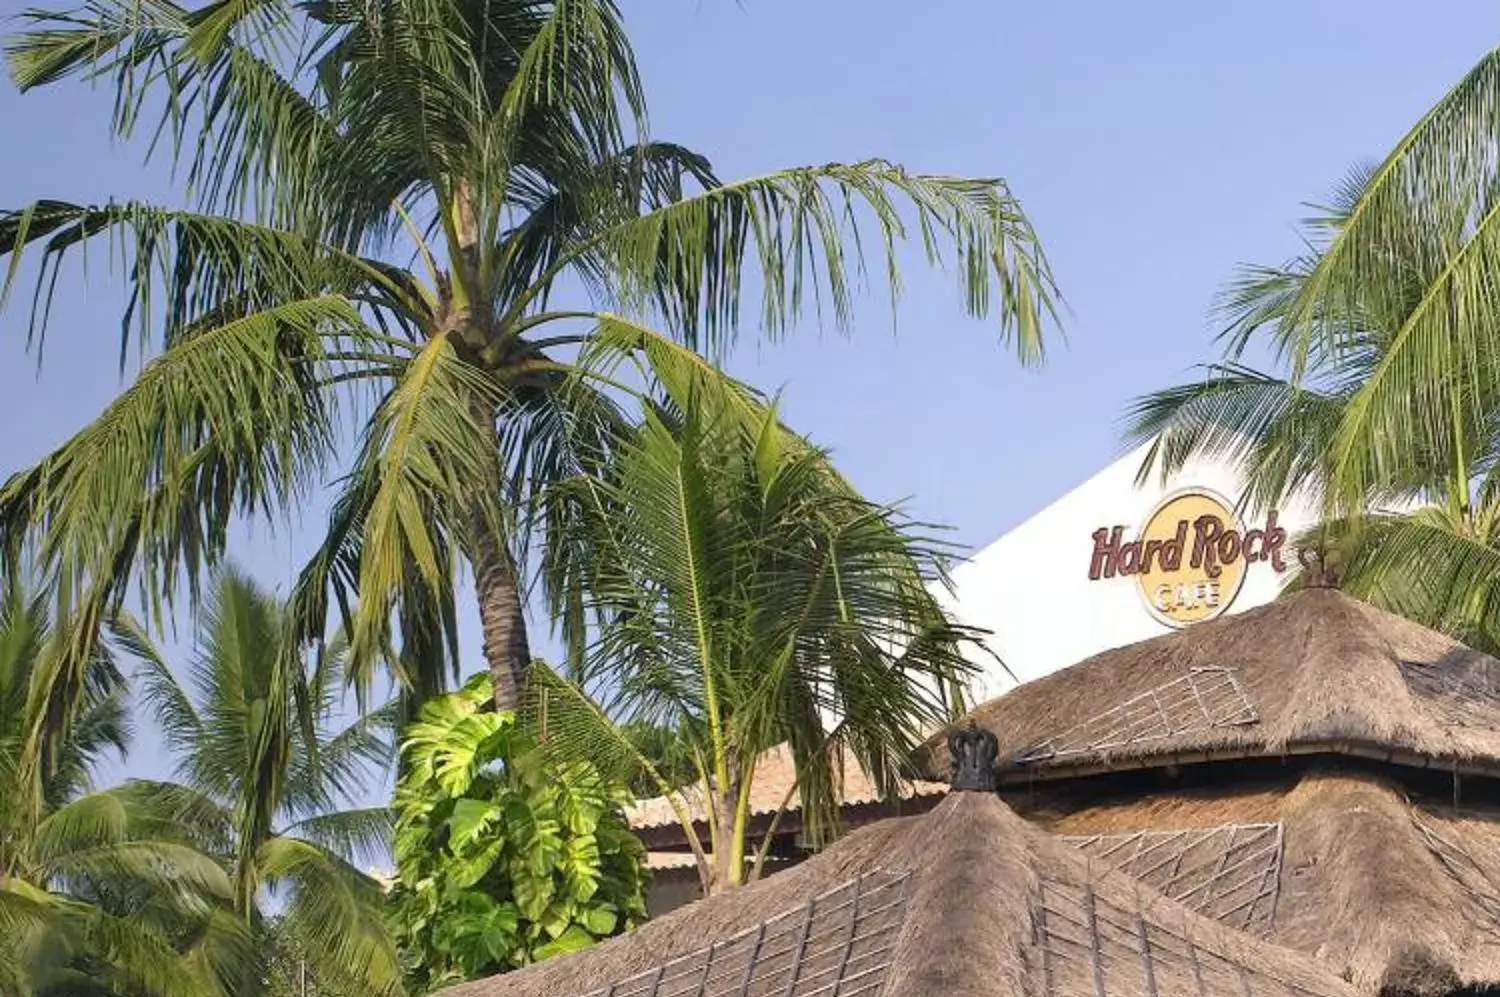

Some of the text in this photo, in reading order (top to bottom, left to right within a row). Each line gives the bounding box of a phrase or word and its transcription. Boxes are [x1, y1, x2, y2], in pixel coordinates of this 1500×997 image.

[1088, 510, 1287, 580] Hard Rock
[1155, 581, 1221, 613] CAFE
